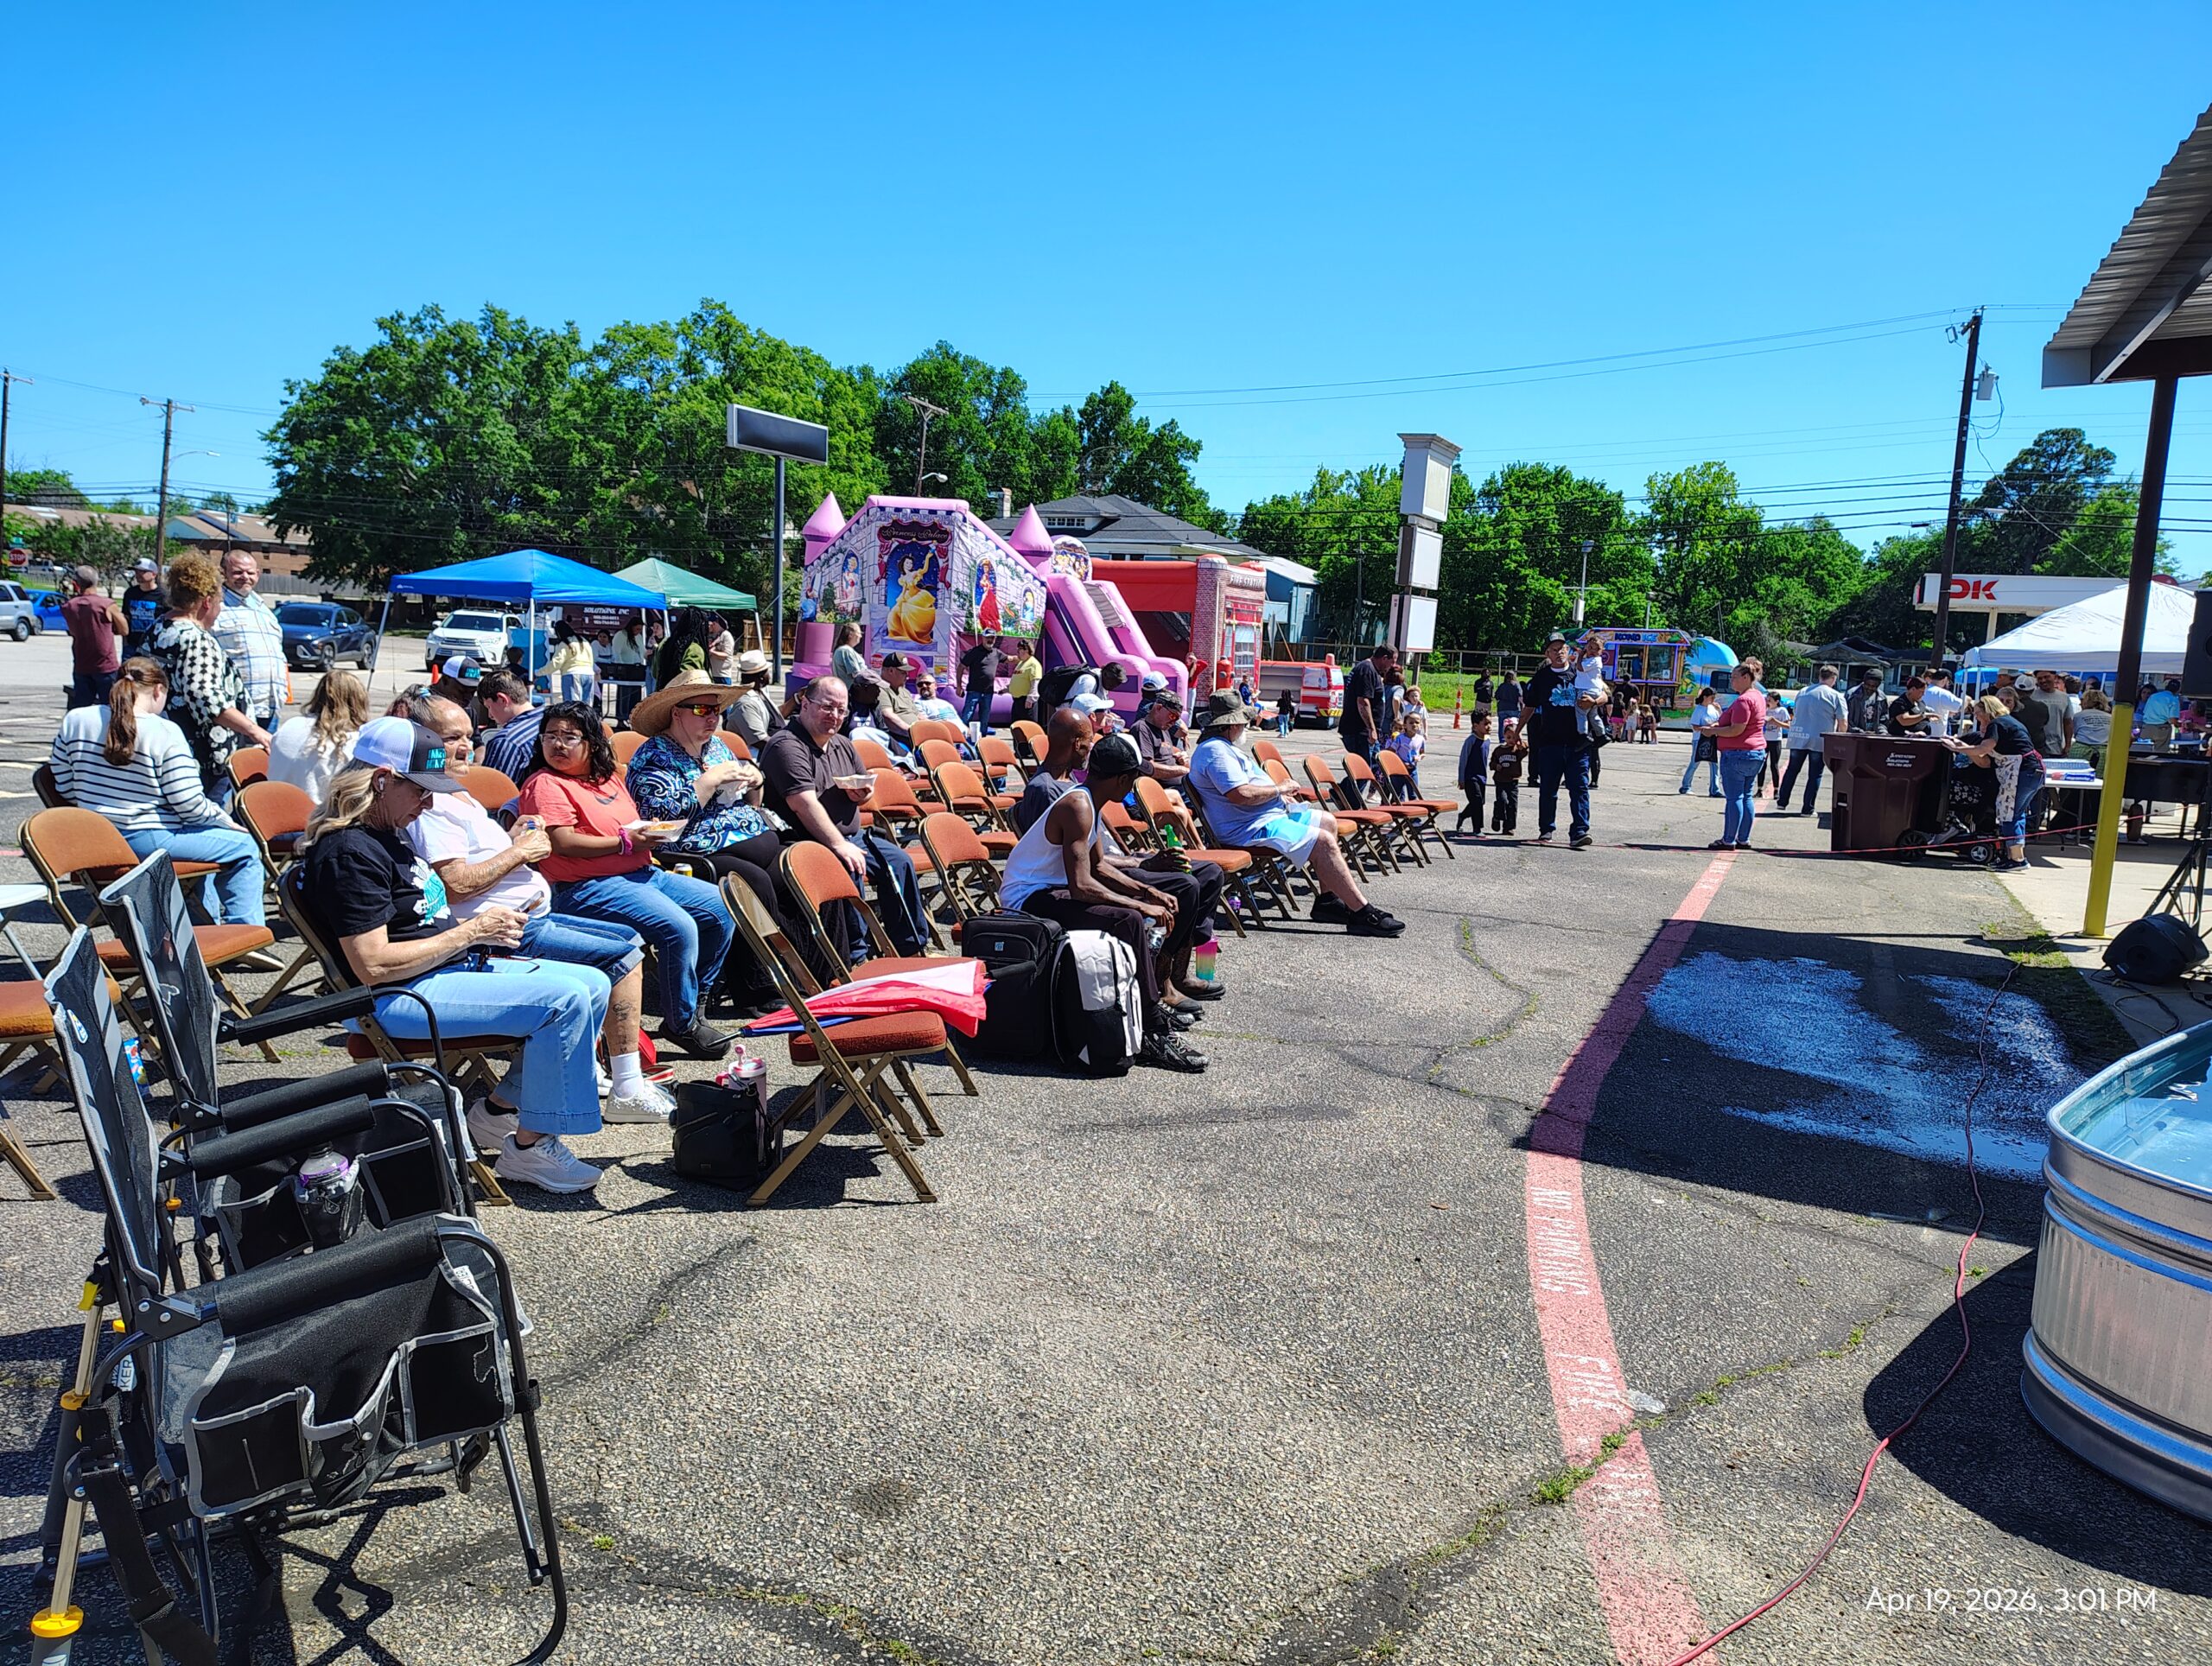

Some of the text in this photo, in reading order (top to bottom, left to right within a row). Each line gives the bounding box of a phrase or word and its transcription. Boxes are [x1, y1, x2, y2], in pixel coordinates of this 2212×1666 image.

[881, 527, 948, 539] Princess Palace
[1949, 579, 1999, 601] DK
[1642, 633, 1658, 641] ICE
[119, 1359, 132, 1389] KER
